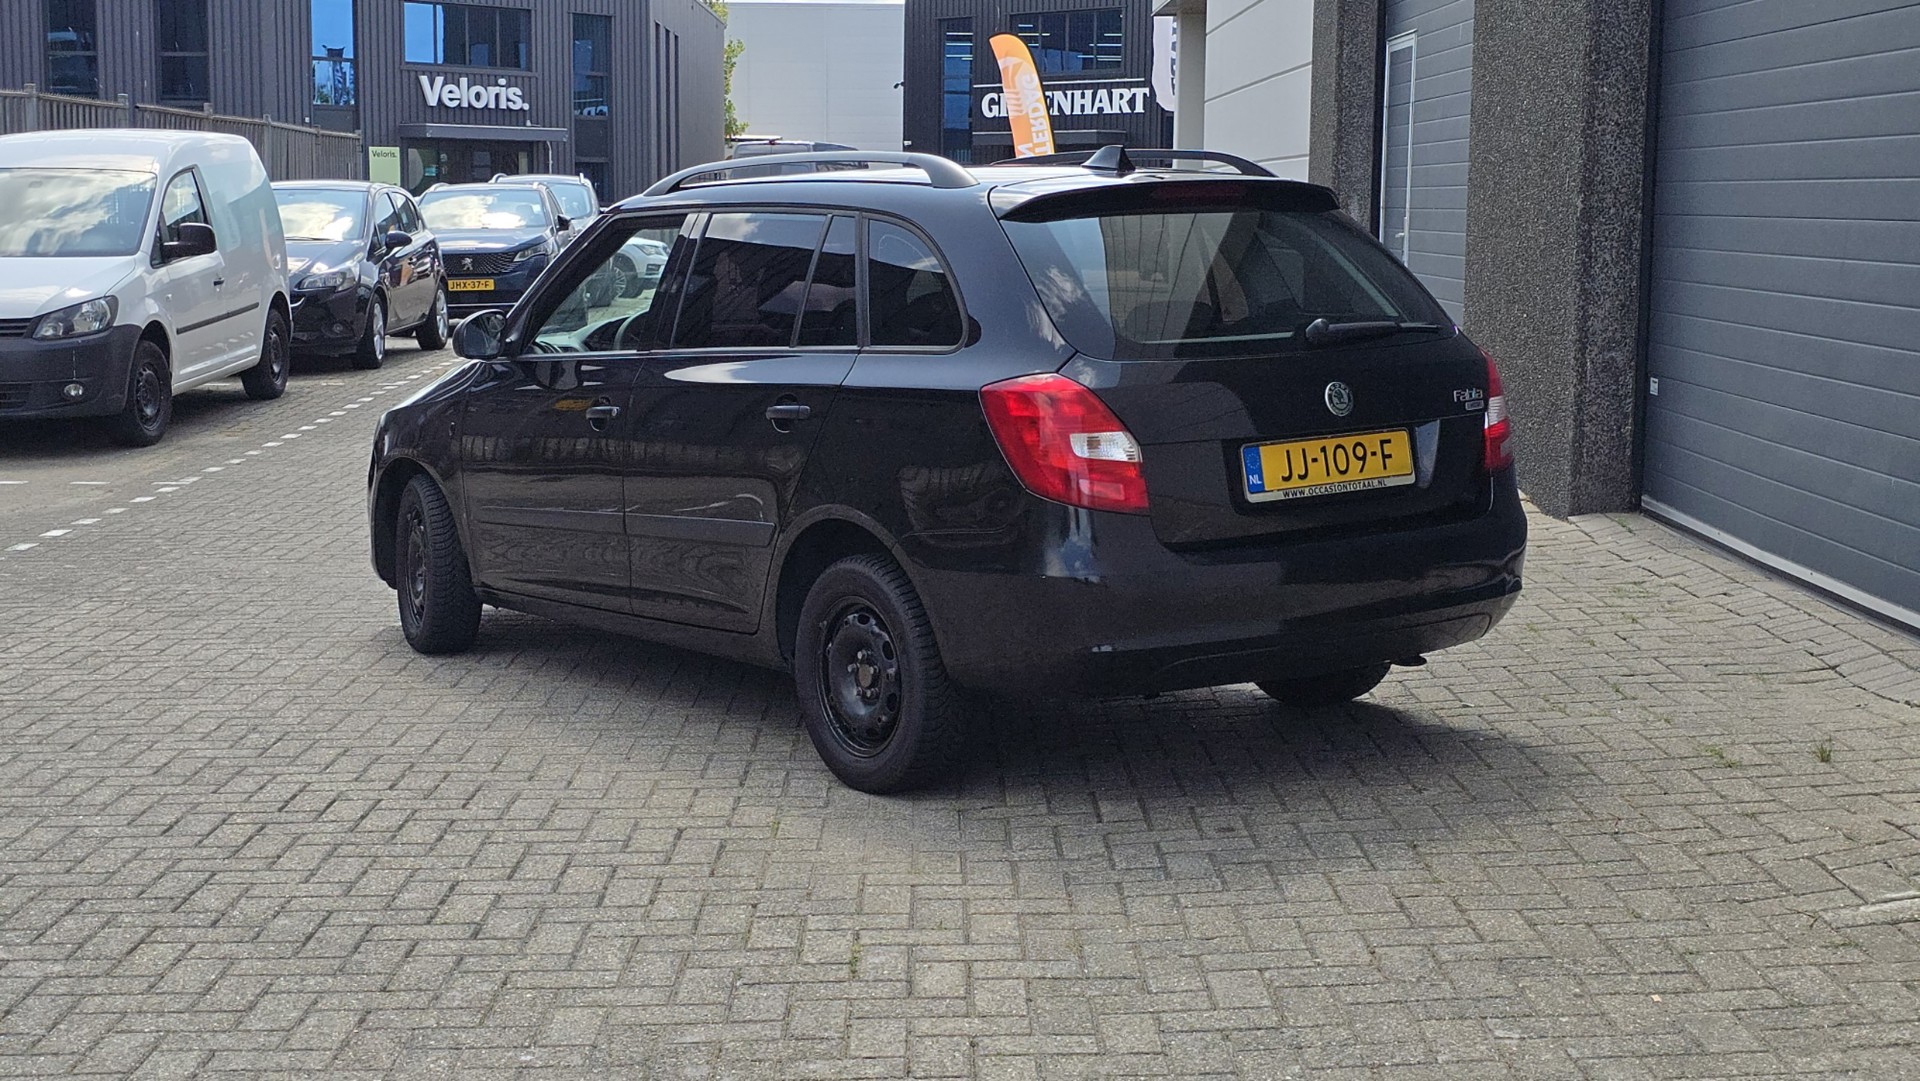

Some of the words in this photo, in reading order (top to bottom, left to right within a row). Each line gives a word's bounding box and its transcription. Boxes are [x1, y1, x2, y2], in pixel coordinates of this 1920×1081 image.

[418, 75, 530, 111] Veloris.
[981, 87, 1150, 118] GNHART
[371, 150, 398, 158] Veloris.
[1453, 387, 1483, 403] Fabia
[1281, 438, 1393, 483] JJ-109-F
[1249, 474, 1263, 485] NL
[1282, 479, 1388, 499] WWW.OCCASIONTOTAAL.NL
